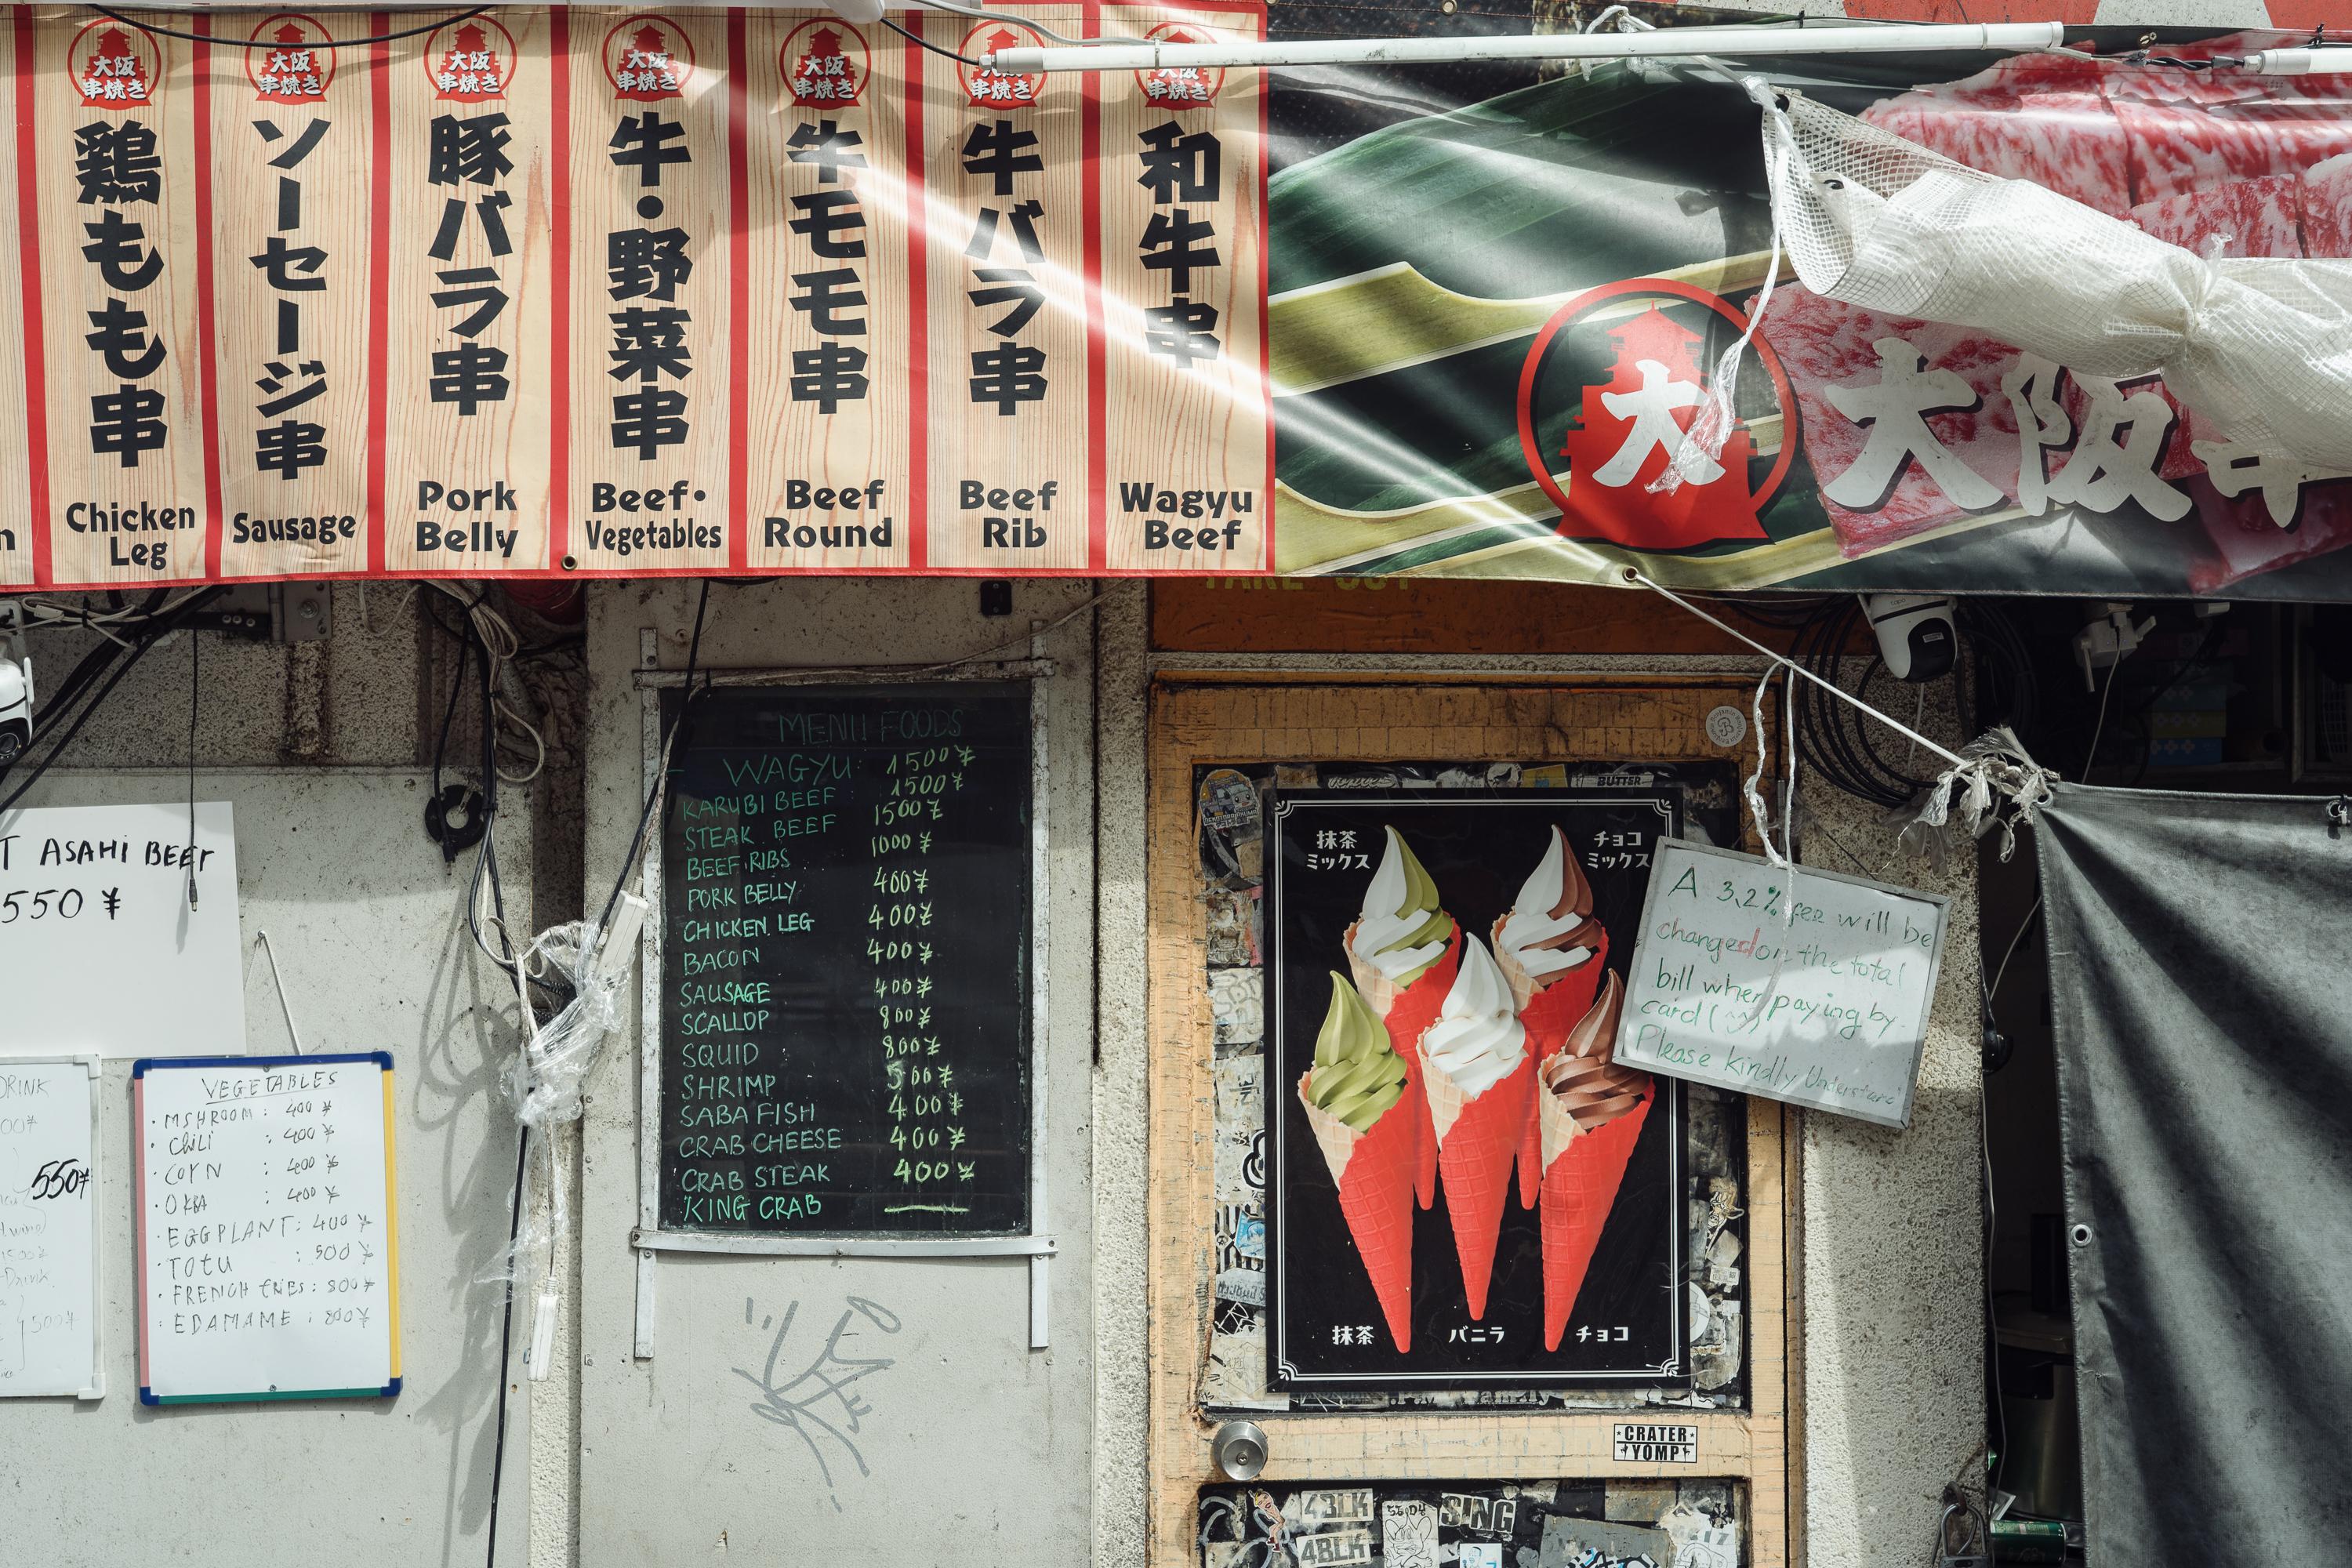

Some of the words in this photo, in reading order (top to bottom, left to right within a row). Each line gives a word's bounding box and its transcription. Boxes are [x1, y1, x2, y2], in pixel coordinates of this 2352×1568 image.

[92, 55, 136, 80] 大阪
[270, 50, 312, 74] 大阪
[447, 49, 491, 73] 大阪
[627, 50, 669, 72] 大阪
[804, 55, 845, 77] 大阪
[82, 77, 147, 100] 串焼き
[258, 74, 321, 97] 串焼き
[436, 73, 501, 95] 串焼き
[616, 71, 681, 93] 串焼き
[793, 78, 855, 100] 串焼き
[971, 79, 1032, 100] 串焼き
[1148, 79, 1208, 100] 串焼き
[1138, 120, 1221, 368] 和牛串
[428, 111, 514, 416] 豚バラ串
[786, 119, 869, 414] 牛モモ串
[962, 120, 1048, 416] 牛バラ串
[74, 120, 168, 468] 鶏もも串
[249, 118, 332, 480] ソーセージ串
[608, 111, 693, 461] 牛・野菜串
[1594, 359, 1726, 488] 大
[418, 481, 517, 511] Pork
[786, 480, 884, 510] Beef
[960, 480, 1058, 511] Beef
[1120, 482, 1253, 519] Wagyu
[66, 501, 195, 533] Chicken
[233, 511, 356, 545] Sausage
[416, 521, 519, 557] Belly
[585, 518, 721, 555] Vegetables
[764, 517, 892, 548] Round
[983, 517, 1047, 548] Rib
[1145, 520, 1241, 550] Beef
[110, 535, 167, 570] Leg
[881, 709, 964, 742] FOODS
[723, 753, 851, 786] WAGYU
[1596, 775, 1641, 787] BUTTER
[683, 793, 765, 821] KARUBI
[776, 786, 837, 811] BEEF
[686, 826, 753, 851] STEAK
[774, 814, 837, 840] BEEF
[1316, 829, 1357, 850] 抹茶
[1594, 829, 1643, 848] チョコ
[687, 853, 739, 881] BEEF
[750, 849, 789, 870] RIBS
[1306, 853, 1370, 870] ミックス
[1587, 851, 1650, 870] ミックス
[1, 888, 84, 923] 550
[688, 887, 736, 911] PORK
[744, 880, 797, 905] BELLY
[1668, 866, 1697, 898] A
[1788, 902, 1825, 928] fee
[1838, 911, 1889, 936] will
[1904, 916, 1933, 948] be
[683, 916, 767, 943] CHICKEN
[778, 913, 815, 933] LEG
[684, 947, 760, 976] BACON
[1799, 946, 1841, 975] the
[1851, 956, 1907, 987] total
[681, 982, 771, 1007] SAUSAGE
[1656, 957, 1694, 992] bill
[1769, 992, 1863, 1040] paying
[682, 1009, 769, 1036] SCALLOP
[1640, 996, 1703, 1024] card
[682, 1043, 759, 1068] SQUID
[1635, 1023, 1710, 1068] Please
[1724, 1045, 1799, 1089] kindly
[201, 1071, 338, 1099] VEGETABLES
[681, 1073, 776, 1100] SHRIMP
[680, 1103, 749, 1127] SABA
[757, 1102, 815, 1125] FISH
[680, 1135, 745, 1159] CRAB
[753, 1129, 842, 1153] CHEESE
[681, 1169, 744, 1193] CRAB
[754, 1163, 831, 1188] STEAK
[683, 1196, 751, 1223] KING
[759, 1193, 822, 1221] CRAB
[174, 1310, 291, 1335] EDAMAME
[1331, 1325, 1374, 1346] 抹茶
[1449, 1327, 1505, 1345] バニラ
[1576, 1326, 1628, 1345] チョコ
[1624, 1425, 1687, 1442] CRATER
[1632, 1444, 1679, 1461] YOMP
[1440, 1495, 1515, 1533] SING
[1301, 1533, 1367, 1565] 4BLK
